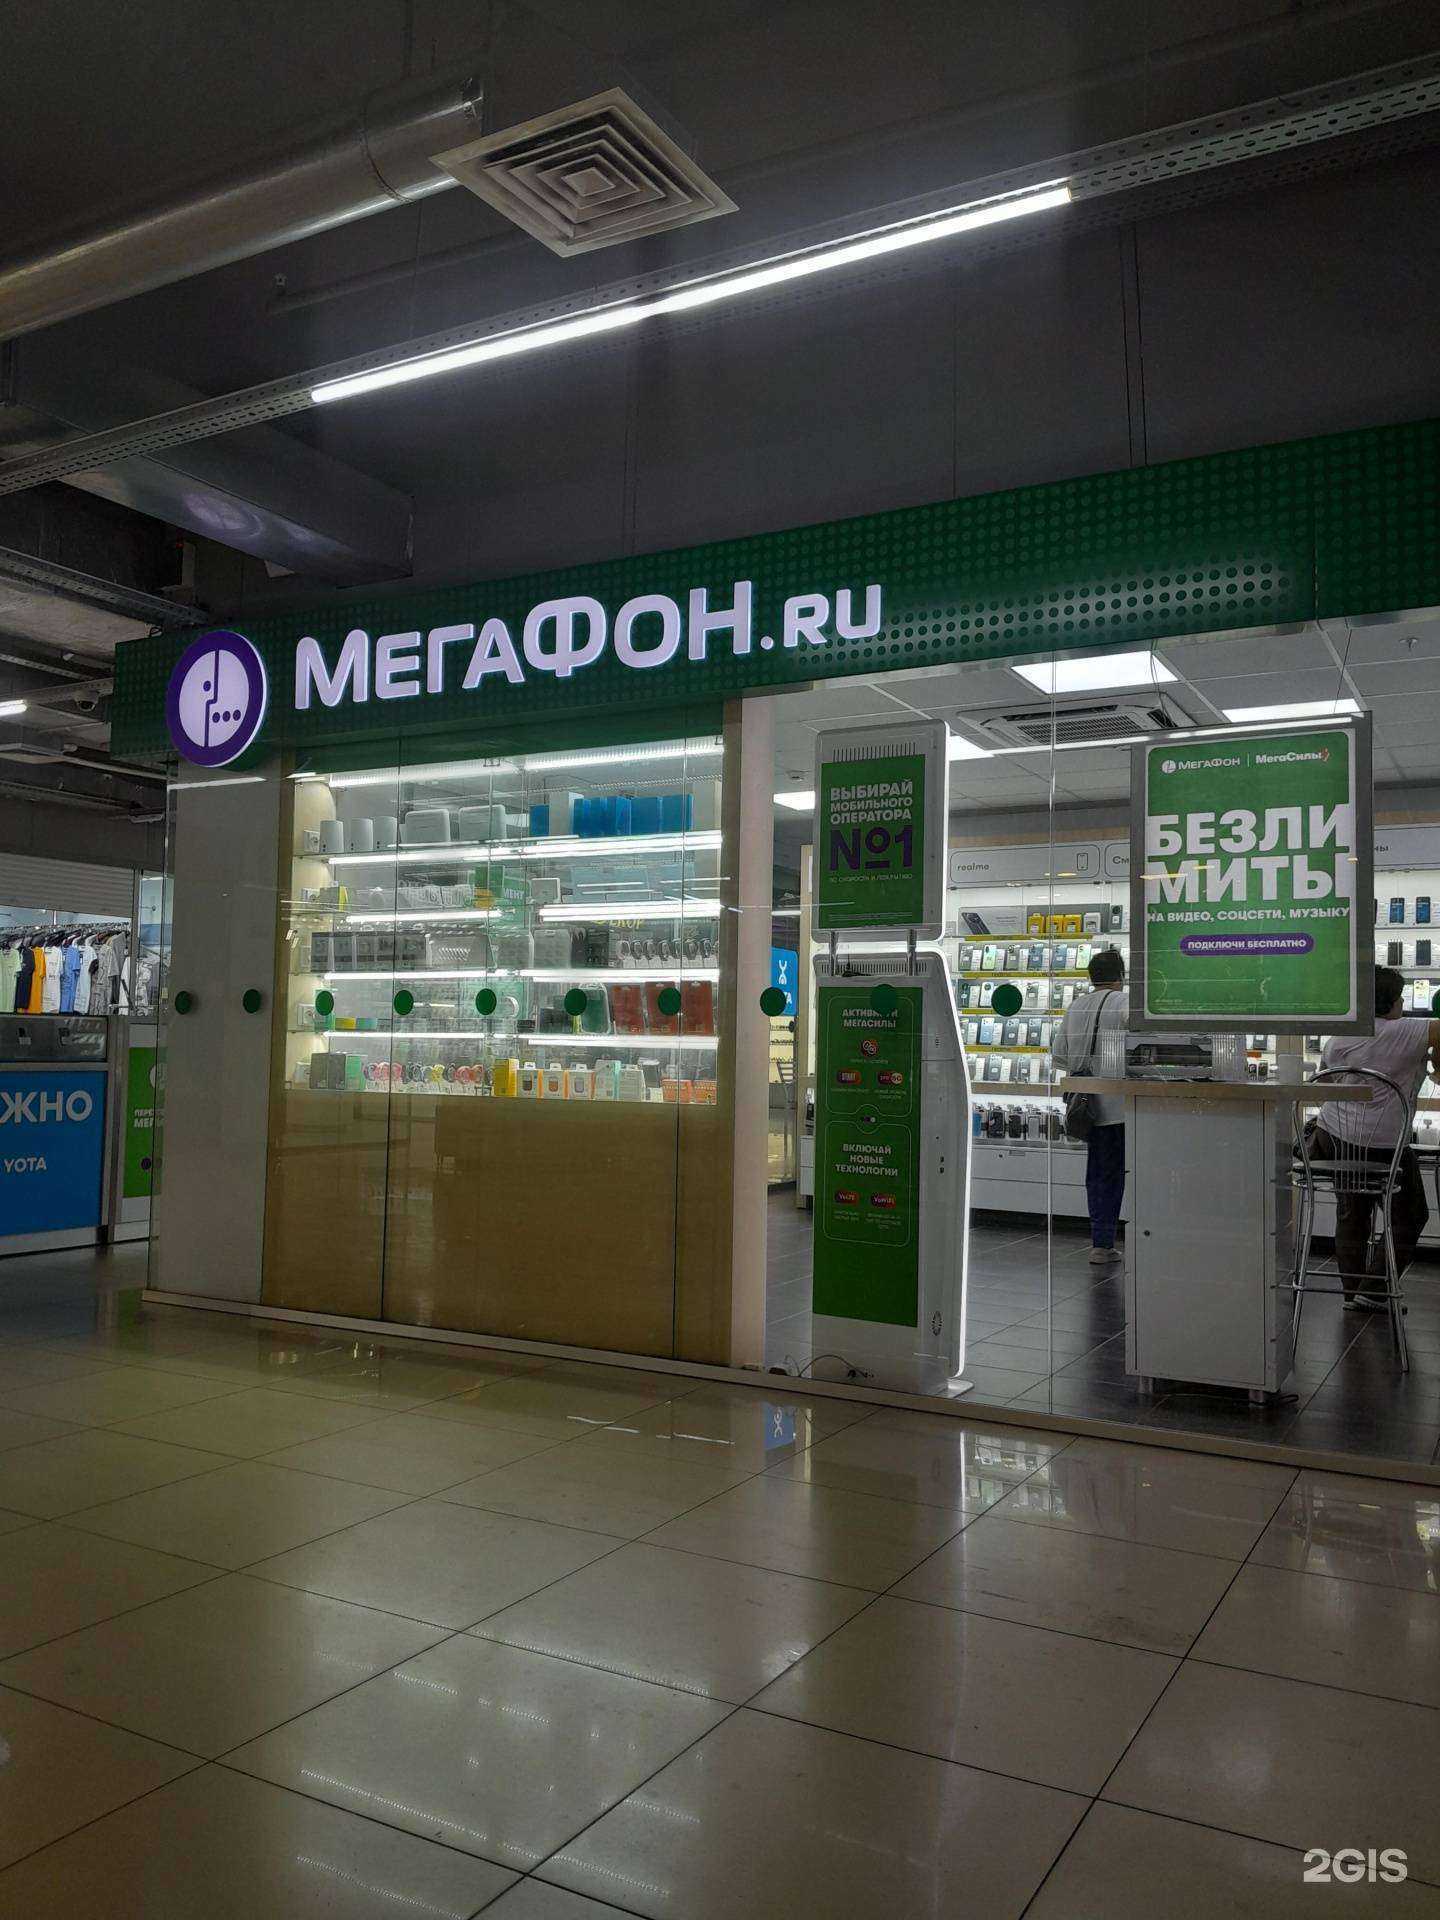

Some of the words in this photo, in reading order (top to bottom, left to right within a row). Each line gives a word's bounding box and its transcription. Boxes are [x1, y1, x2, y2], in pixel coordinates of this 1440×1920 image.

[1178, 758, 1241, 770] МЕГАФОН
[830, 779, 913, 801] ВЫБИРАЙ
[830, 797, 913, 813] МОБИЛЬНОГО
[830, 808, 912, 824] ОПЕРАТОРА
[1147, 803, 1350, 856] БЕЗЛИ
[1146, 852, 1351, 904] МИТЫ
[1147, 912, 1164, 922] НА
[1167, 911, 1214, 923] ВИДЕО,
[1217, 909, 1286, 921] СОЦСЕТИ,
[1289, 907, 1350, 918] МУЗЫКУ
[1187, 940, 1245, 951] ПОДКЛЮЧИ
[1247, 939, 1307, 949] БЕСПЛАТНО
[843, 1019, 896, 1028] МЕГАСИЛЫ
[842, 1143, 892, 1154] ВКЛЮЧАЙ
[4, 1157, 47, 1173] YOTA
[849, 1155, 884, 1165] НОВЫЕ
[835, 1164, 899, 1176] ТЕХНОЛОГИИ
